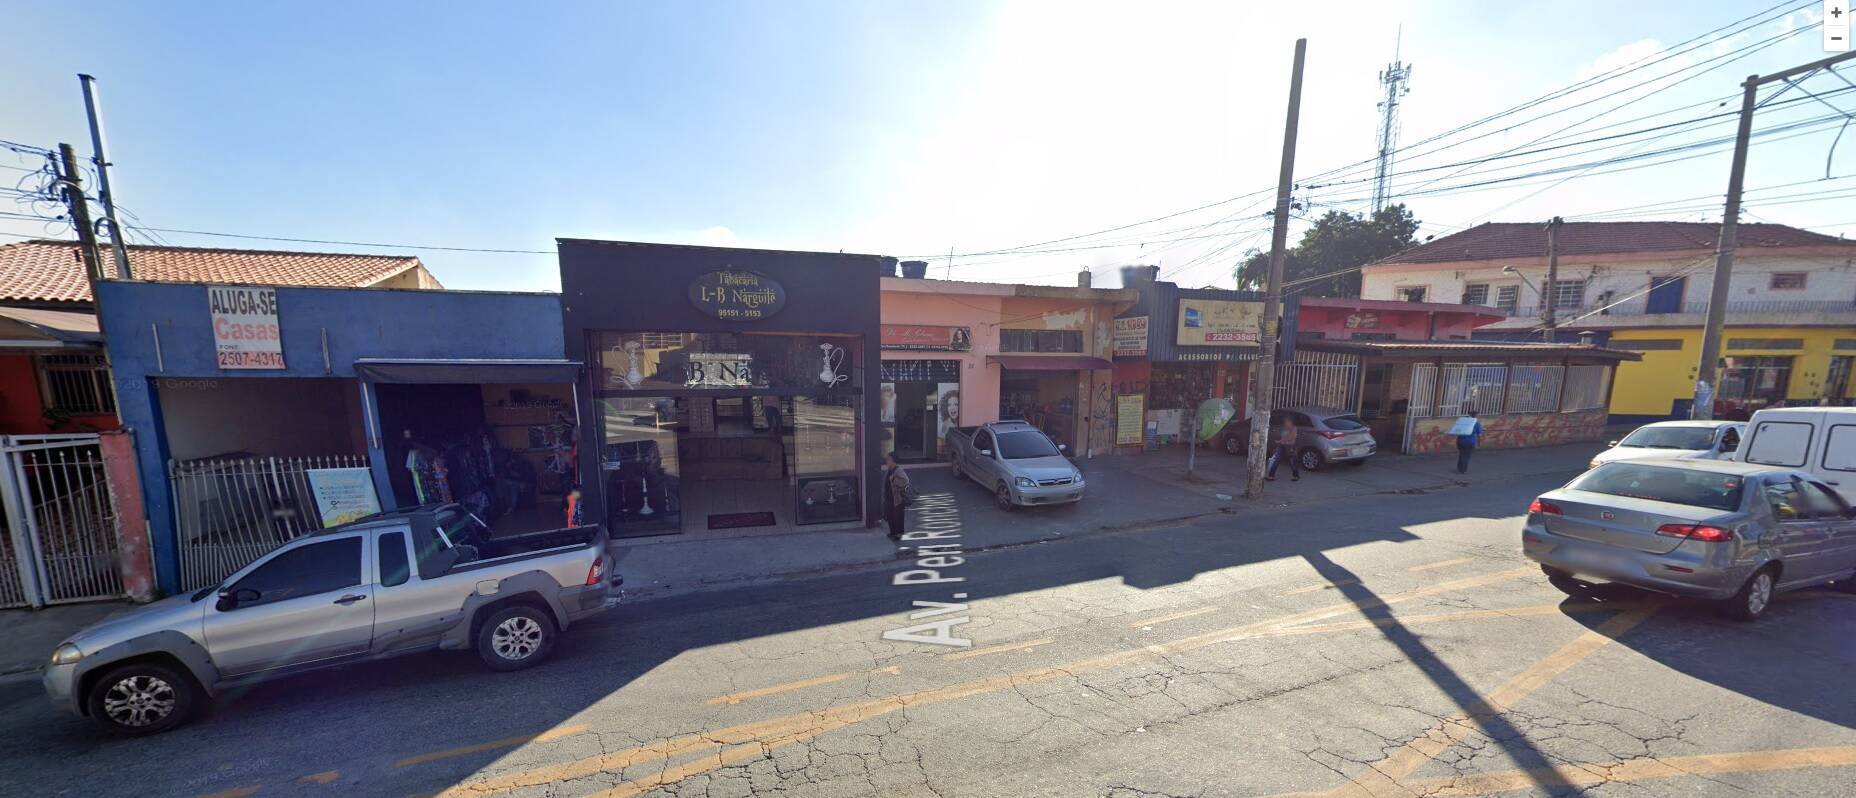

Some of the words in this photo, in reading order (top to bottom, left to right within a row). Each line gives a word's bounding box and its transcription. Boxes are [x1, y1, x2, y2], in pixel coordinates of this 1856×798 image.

[212, 289, 277, 315] ALUGA-SE
[701, 286, 726, 304] L-B
[215, 317, 278, 340] Casas
[219, 351, 283, 366] 2507-4317
